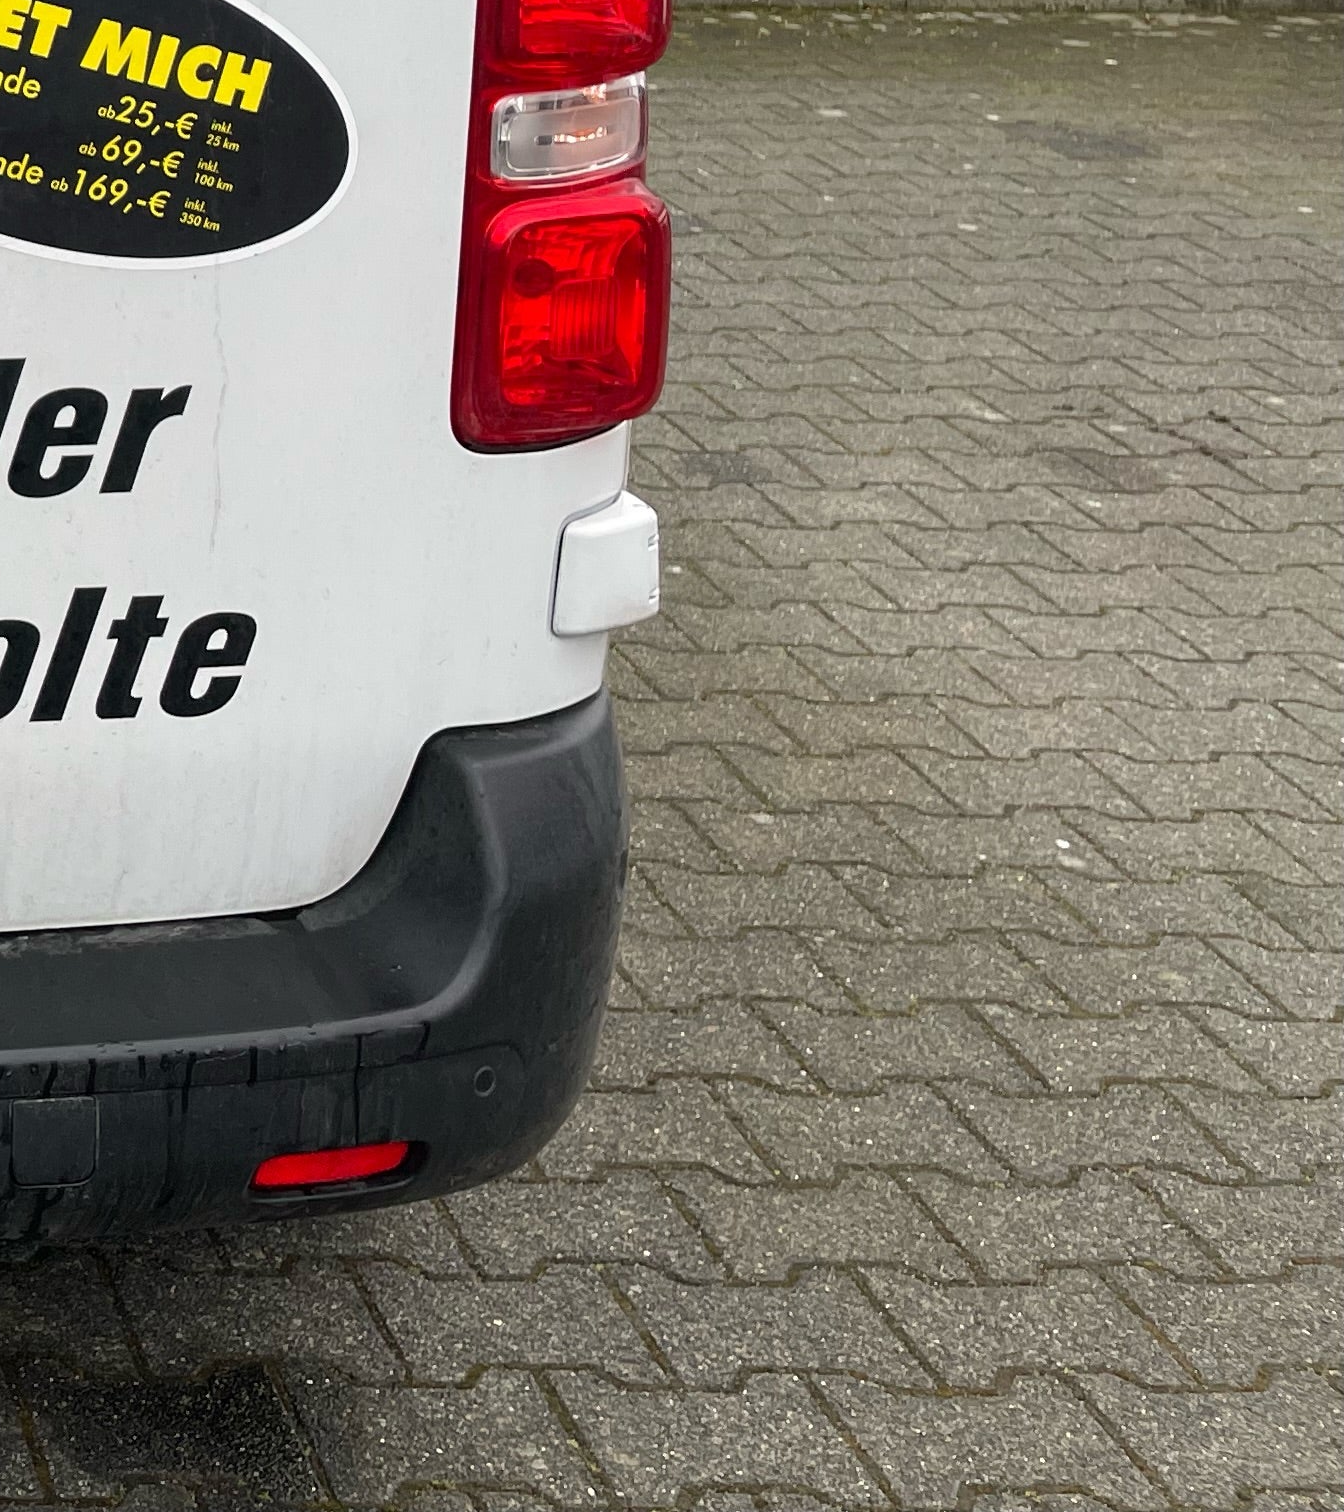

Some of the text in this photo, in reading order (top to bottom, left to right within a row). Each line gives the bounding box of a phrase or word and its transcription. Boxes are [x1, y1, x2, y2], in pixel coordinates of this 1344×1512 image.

[80, 19, 272, 112] MICH
[211, 119, 232, 135] inkl.
[223, 138, 239, 151] km
[79, 142, 97, 156] ab
[102, 136, 183, 177] 69,-€
[198, 159, 218, 173] inkl.
[195, 173, 232, 191] 100 km
[51, 178, 69, 192] ab
[75, 169, 170, 216] 169,-€
[185, 198, 206, 212] inkl.
[180, 212, 221, 231] 350 km
